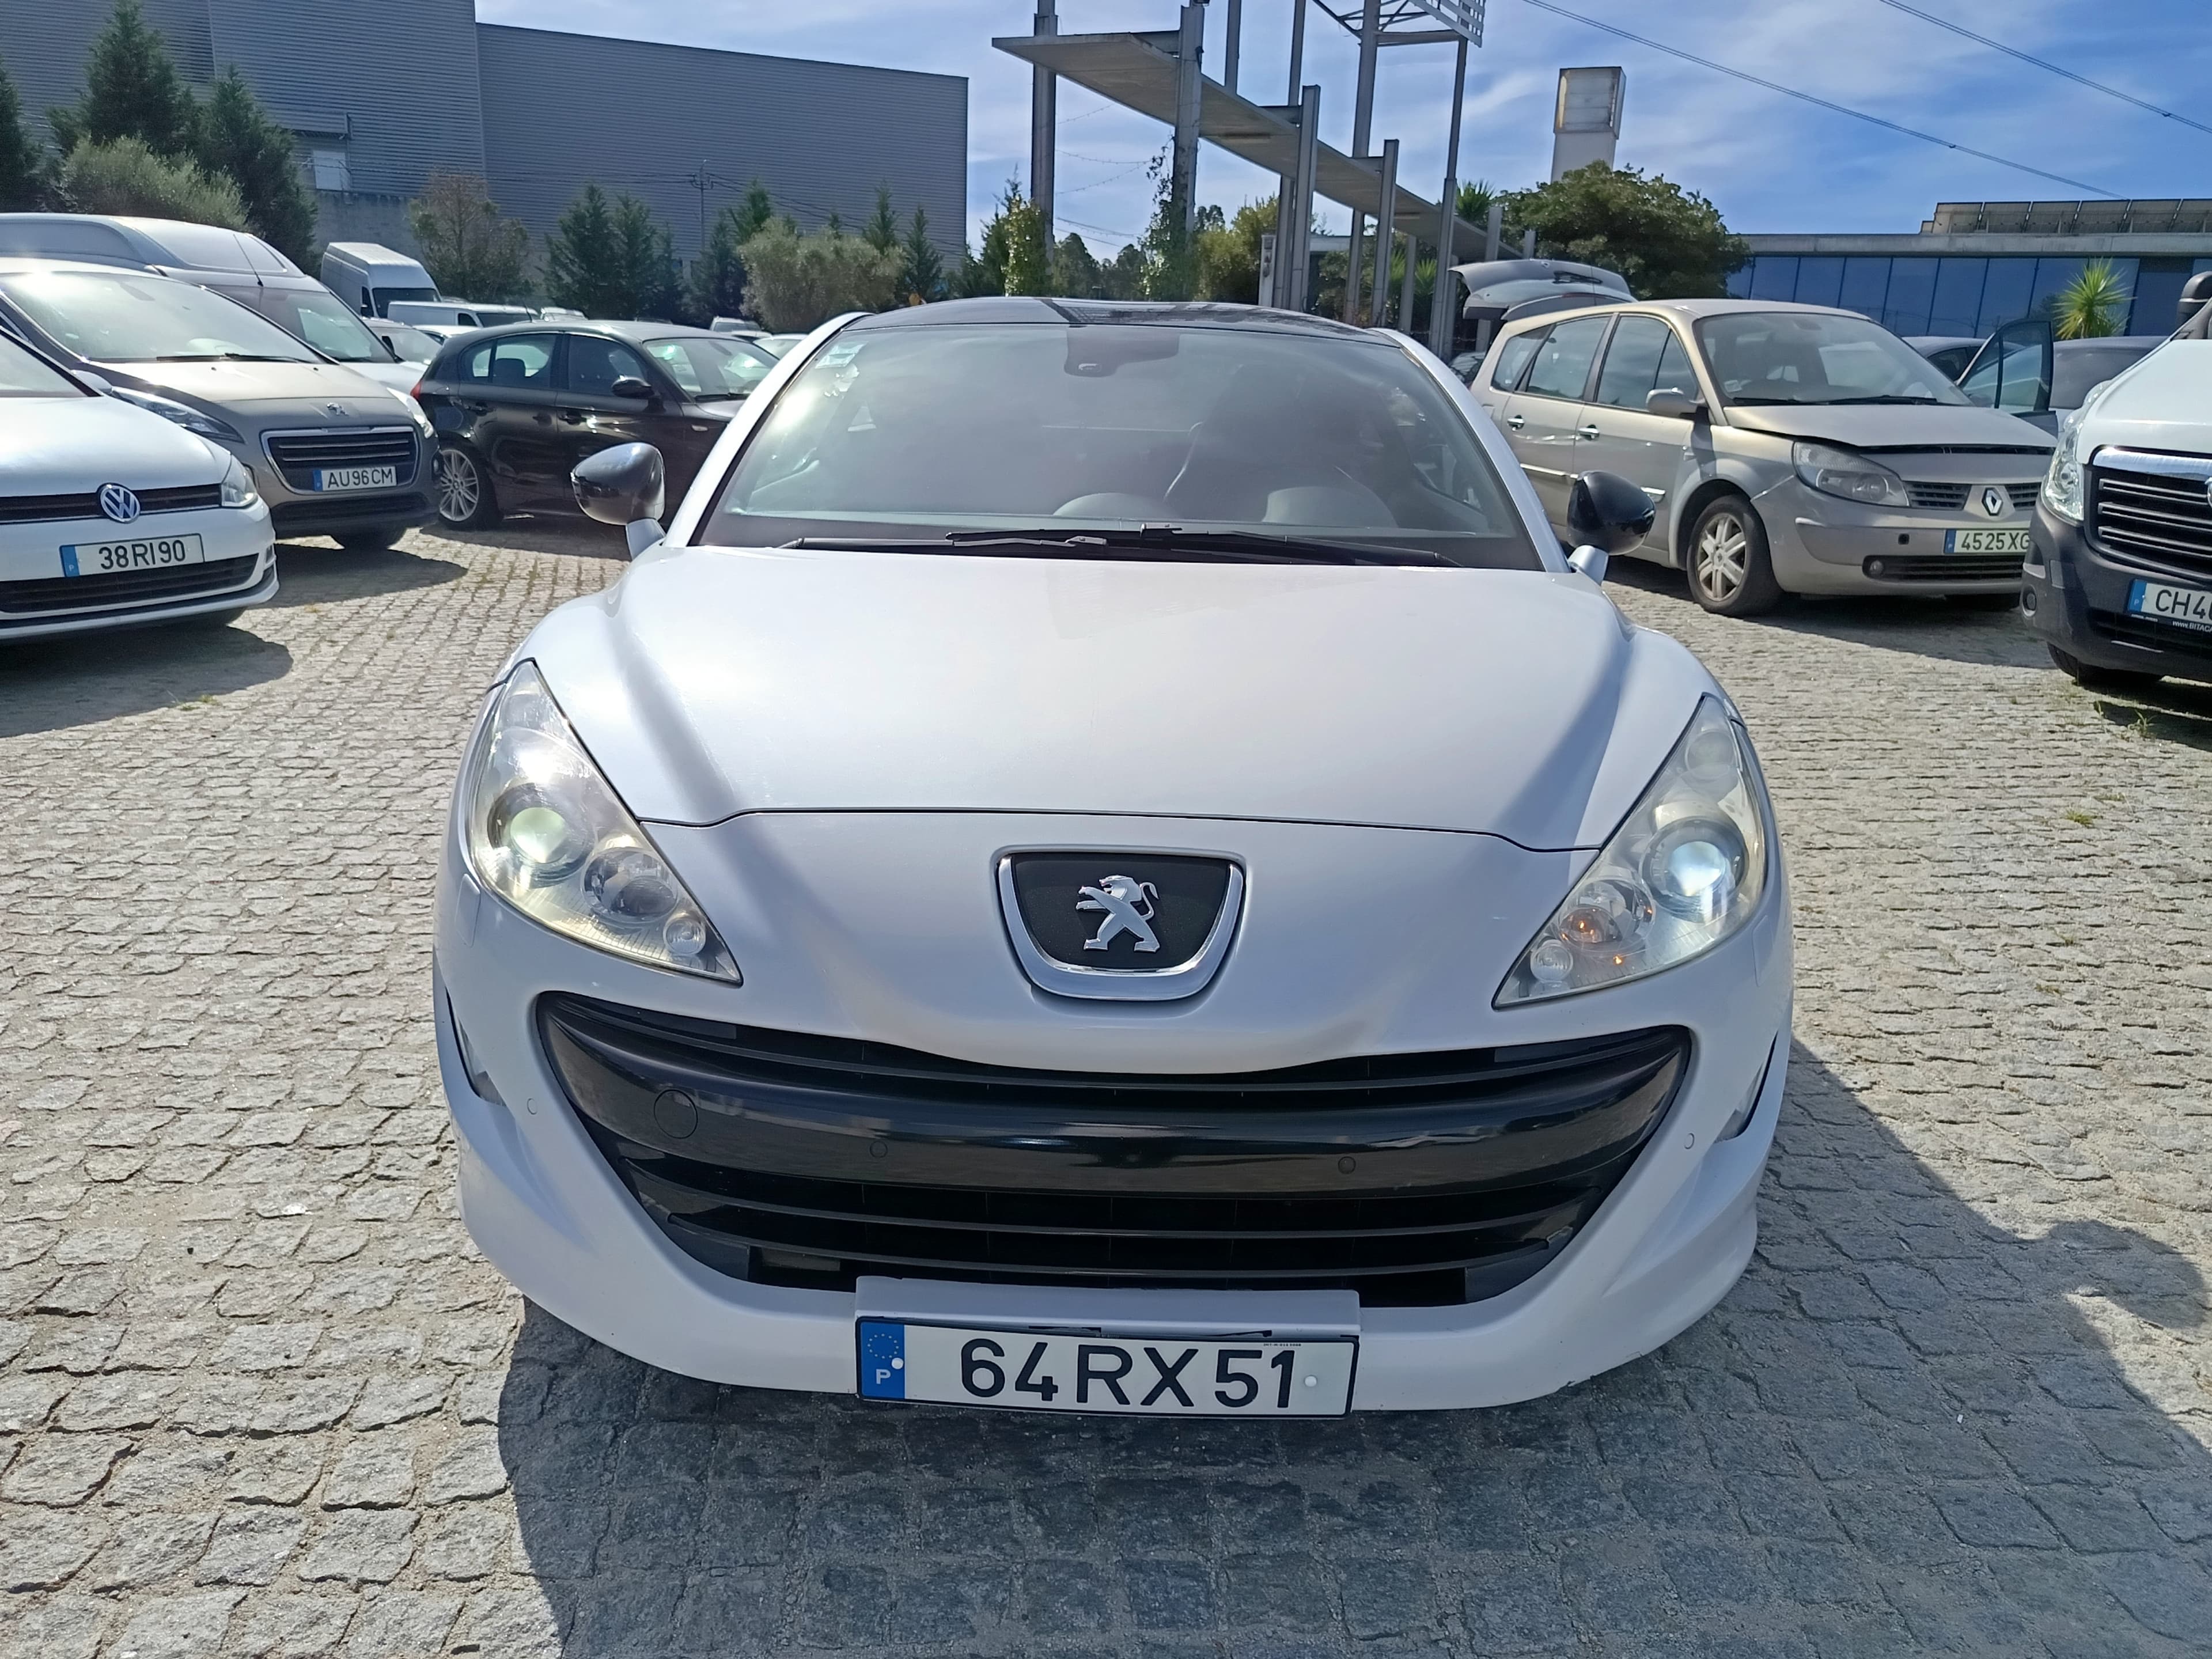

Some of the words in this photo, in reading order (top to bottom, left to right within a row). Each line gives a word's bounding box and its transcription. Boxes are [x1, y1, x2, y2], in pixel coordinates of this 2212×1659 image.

[328, 468, 393, 488] AU96CM
[99, 540, 185, 570] 38RI90
[2156, 589, 2212, 621] CH4
[876, 1368, 891, 1384] P
[960, 1338, 1295, 1408] 64RX51
